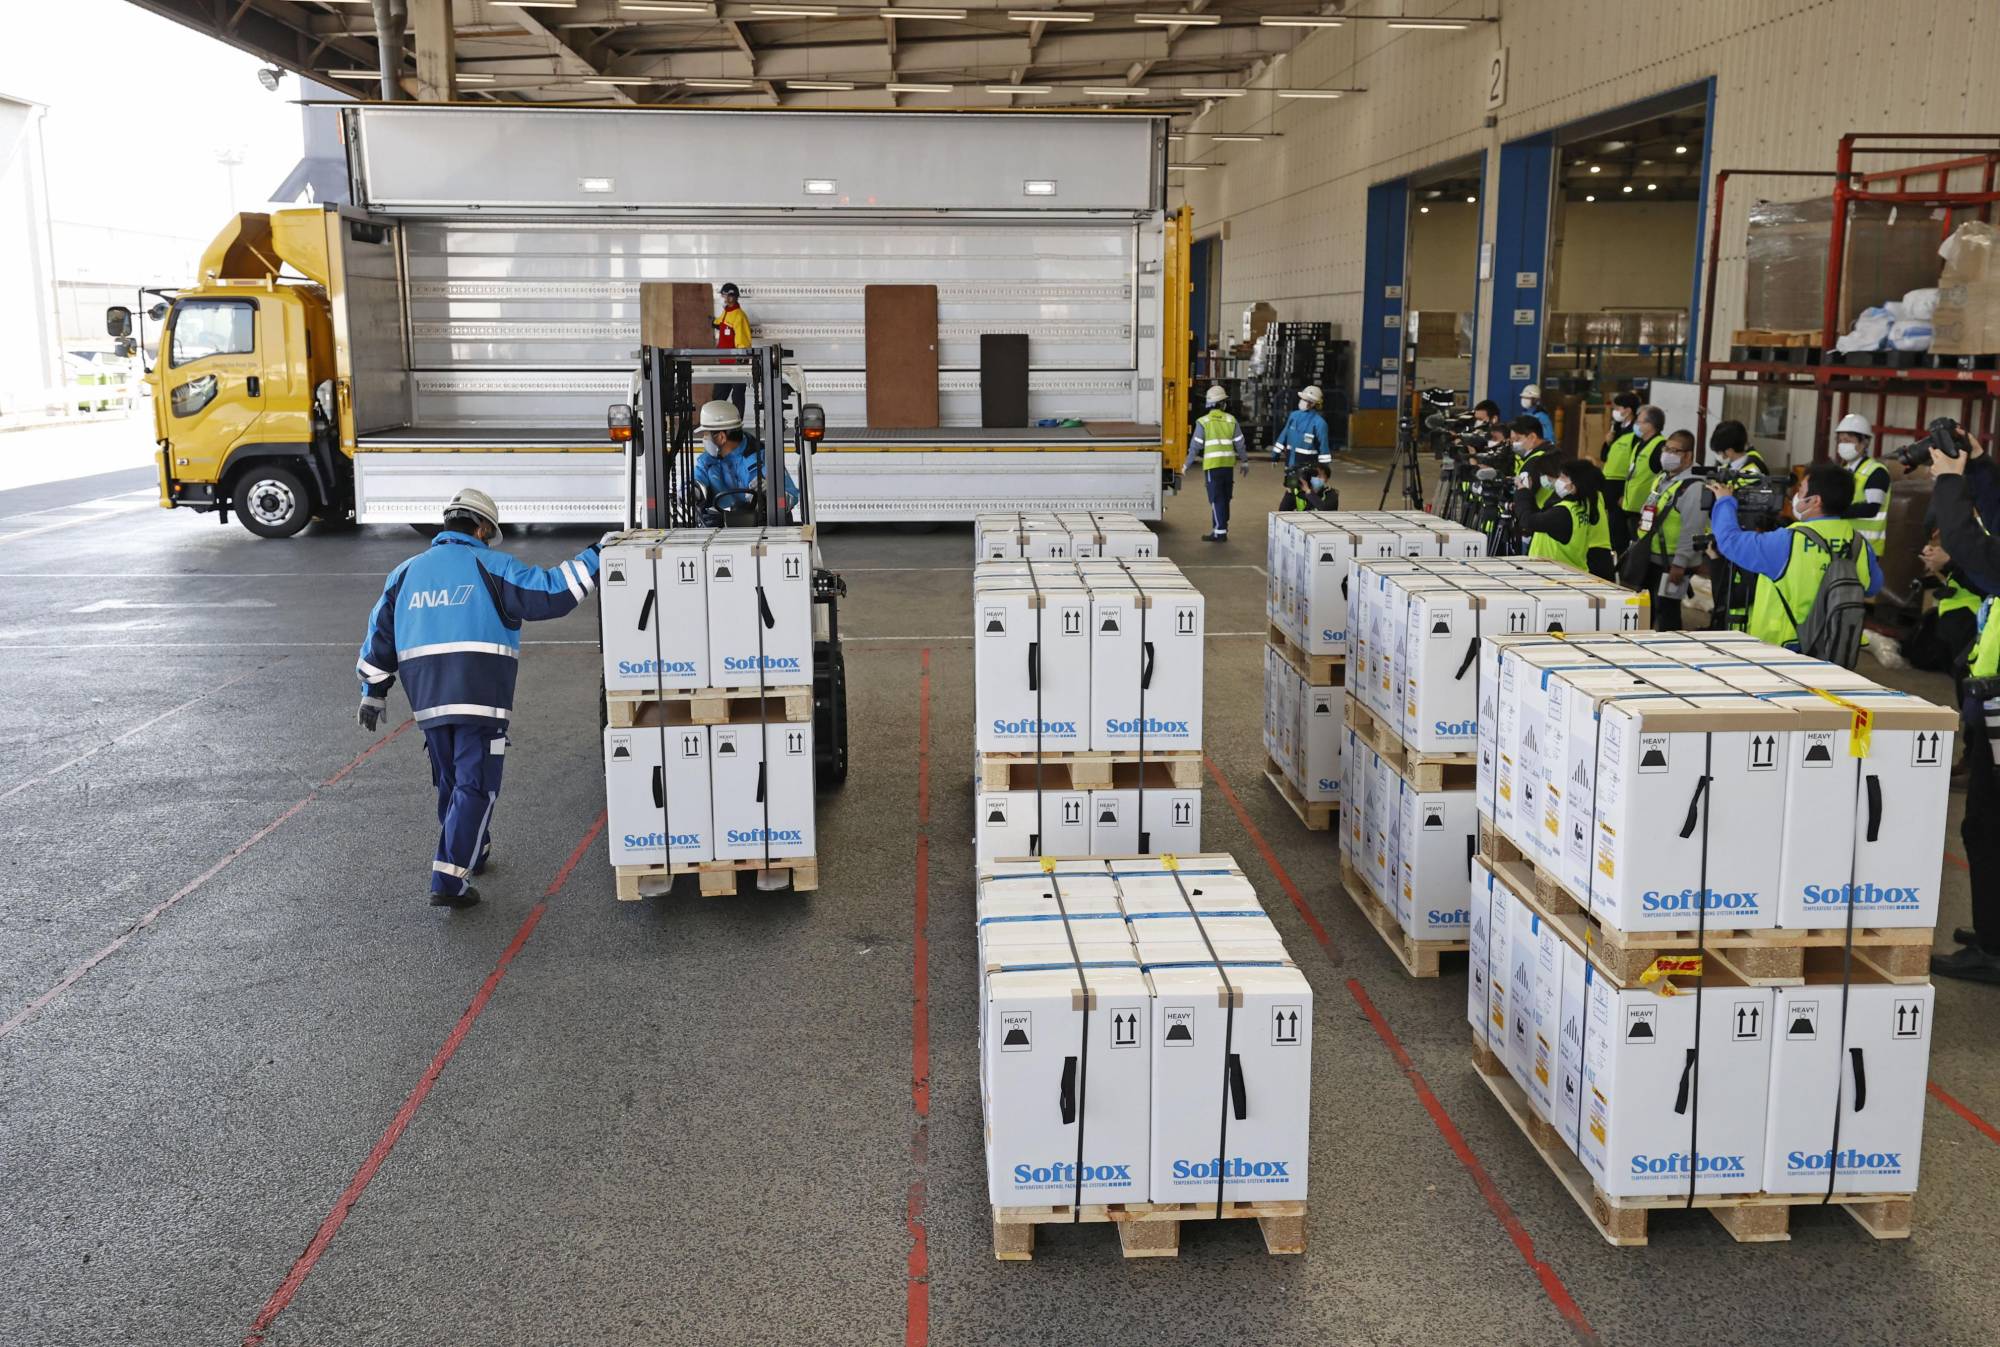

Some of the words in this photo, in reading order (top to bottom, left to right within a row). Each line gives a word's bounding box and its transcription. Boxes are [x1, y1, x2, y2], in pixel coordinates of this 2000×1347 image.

[1490, 58, 1501, 102] 2
[408, 589, 449, 610] ANA
[618, 659, 695, 675] Softbox
[724, 655, 800, 670] Softbox
[993, 718, 1077, 734] Softbox
[1106, 717, 1189, 733] Softbox
[1806, 732, 1832, 740] HEAVY
[624, 832, 700, 848] Softbox
[727, 828, 802, 843] Softbox
[1642, 887, 1759, 911] Softbox
[1803, 883, 1920, 904] Softbox
[1167, 1012, 1191, 1020] HEAVY
[1630, 1010, 1654, 1018] HEAVY
[1631, 1152, 1745, 1174] Softbox
[1787, 1149, 1902, 1170] Softbox
[1014, 1161, 1131, 1183] Softbox
[1173, 1157, 1289, 1179] Softbox
